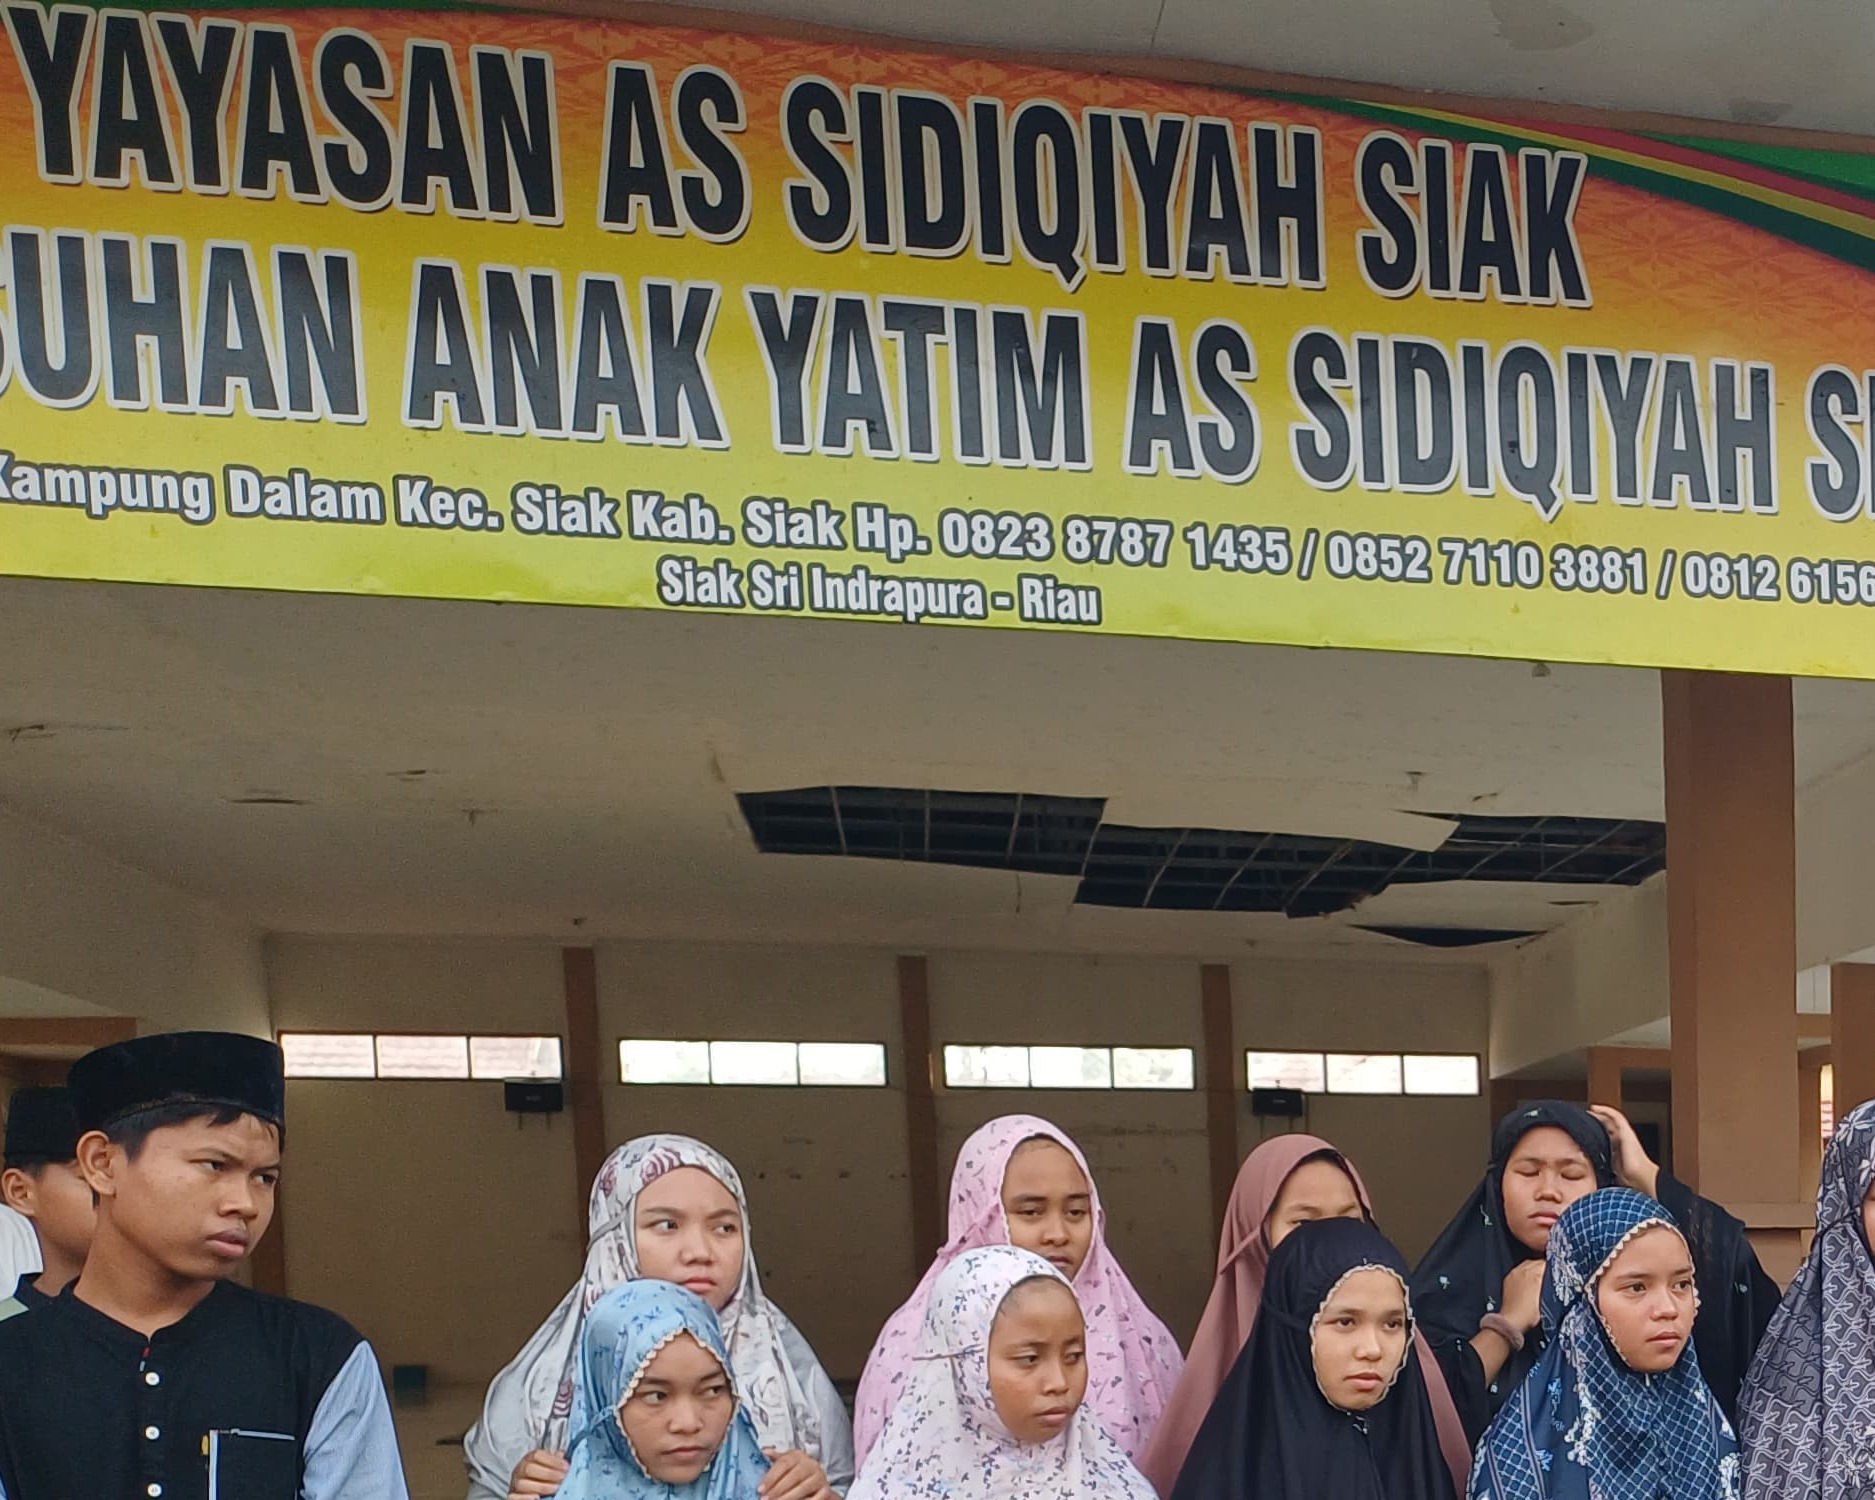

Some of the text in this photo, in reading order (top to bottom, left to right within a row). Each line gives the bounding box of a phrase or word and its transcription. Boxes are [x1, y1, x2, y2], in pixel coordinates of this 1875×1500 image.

[4, 3, 1594, 307] YAYASAN AS SIDIQIYAH SIAK
[0, 224, 368, 424] UHAN
[404, 259, 730, 450] ANAK
[741, 282, 1093, 471] YATIM
[1123, 315, 1261, 484] AS
[1288, 325, 1779, 521] SIDIQIYAH
[224, 463, 387, 525] Dalam
[393, 474, 503, 532] Kec.
[512, 483, 621, 538] Siak
[626, 489, 733, 545] Kab.
[742, 496, 846, 550] Siak
[852, 502, 930, 561] Hp.
[939, 507, 1053, 561] 0823
[1063, 516, 1174, 567] 8787
[1184, 521, 1291, 574] 1435
[1299, 528, 1319, 580] /
[1325, 531, 1431, 582] 0852
[1439, 537, 1543, 588] 7110
[1550, 543, 1647, 594] 3881
[1655, 548, 1677, 600] /
[1681, 551, 1781, 602] 0812
[657, 554, 1102, 625] Siak Sri Indrapura - Riau
